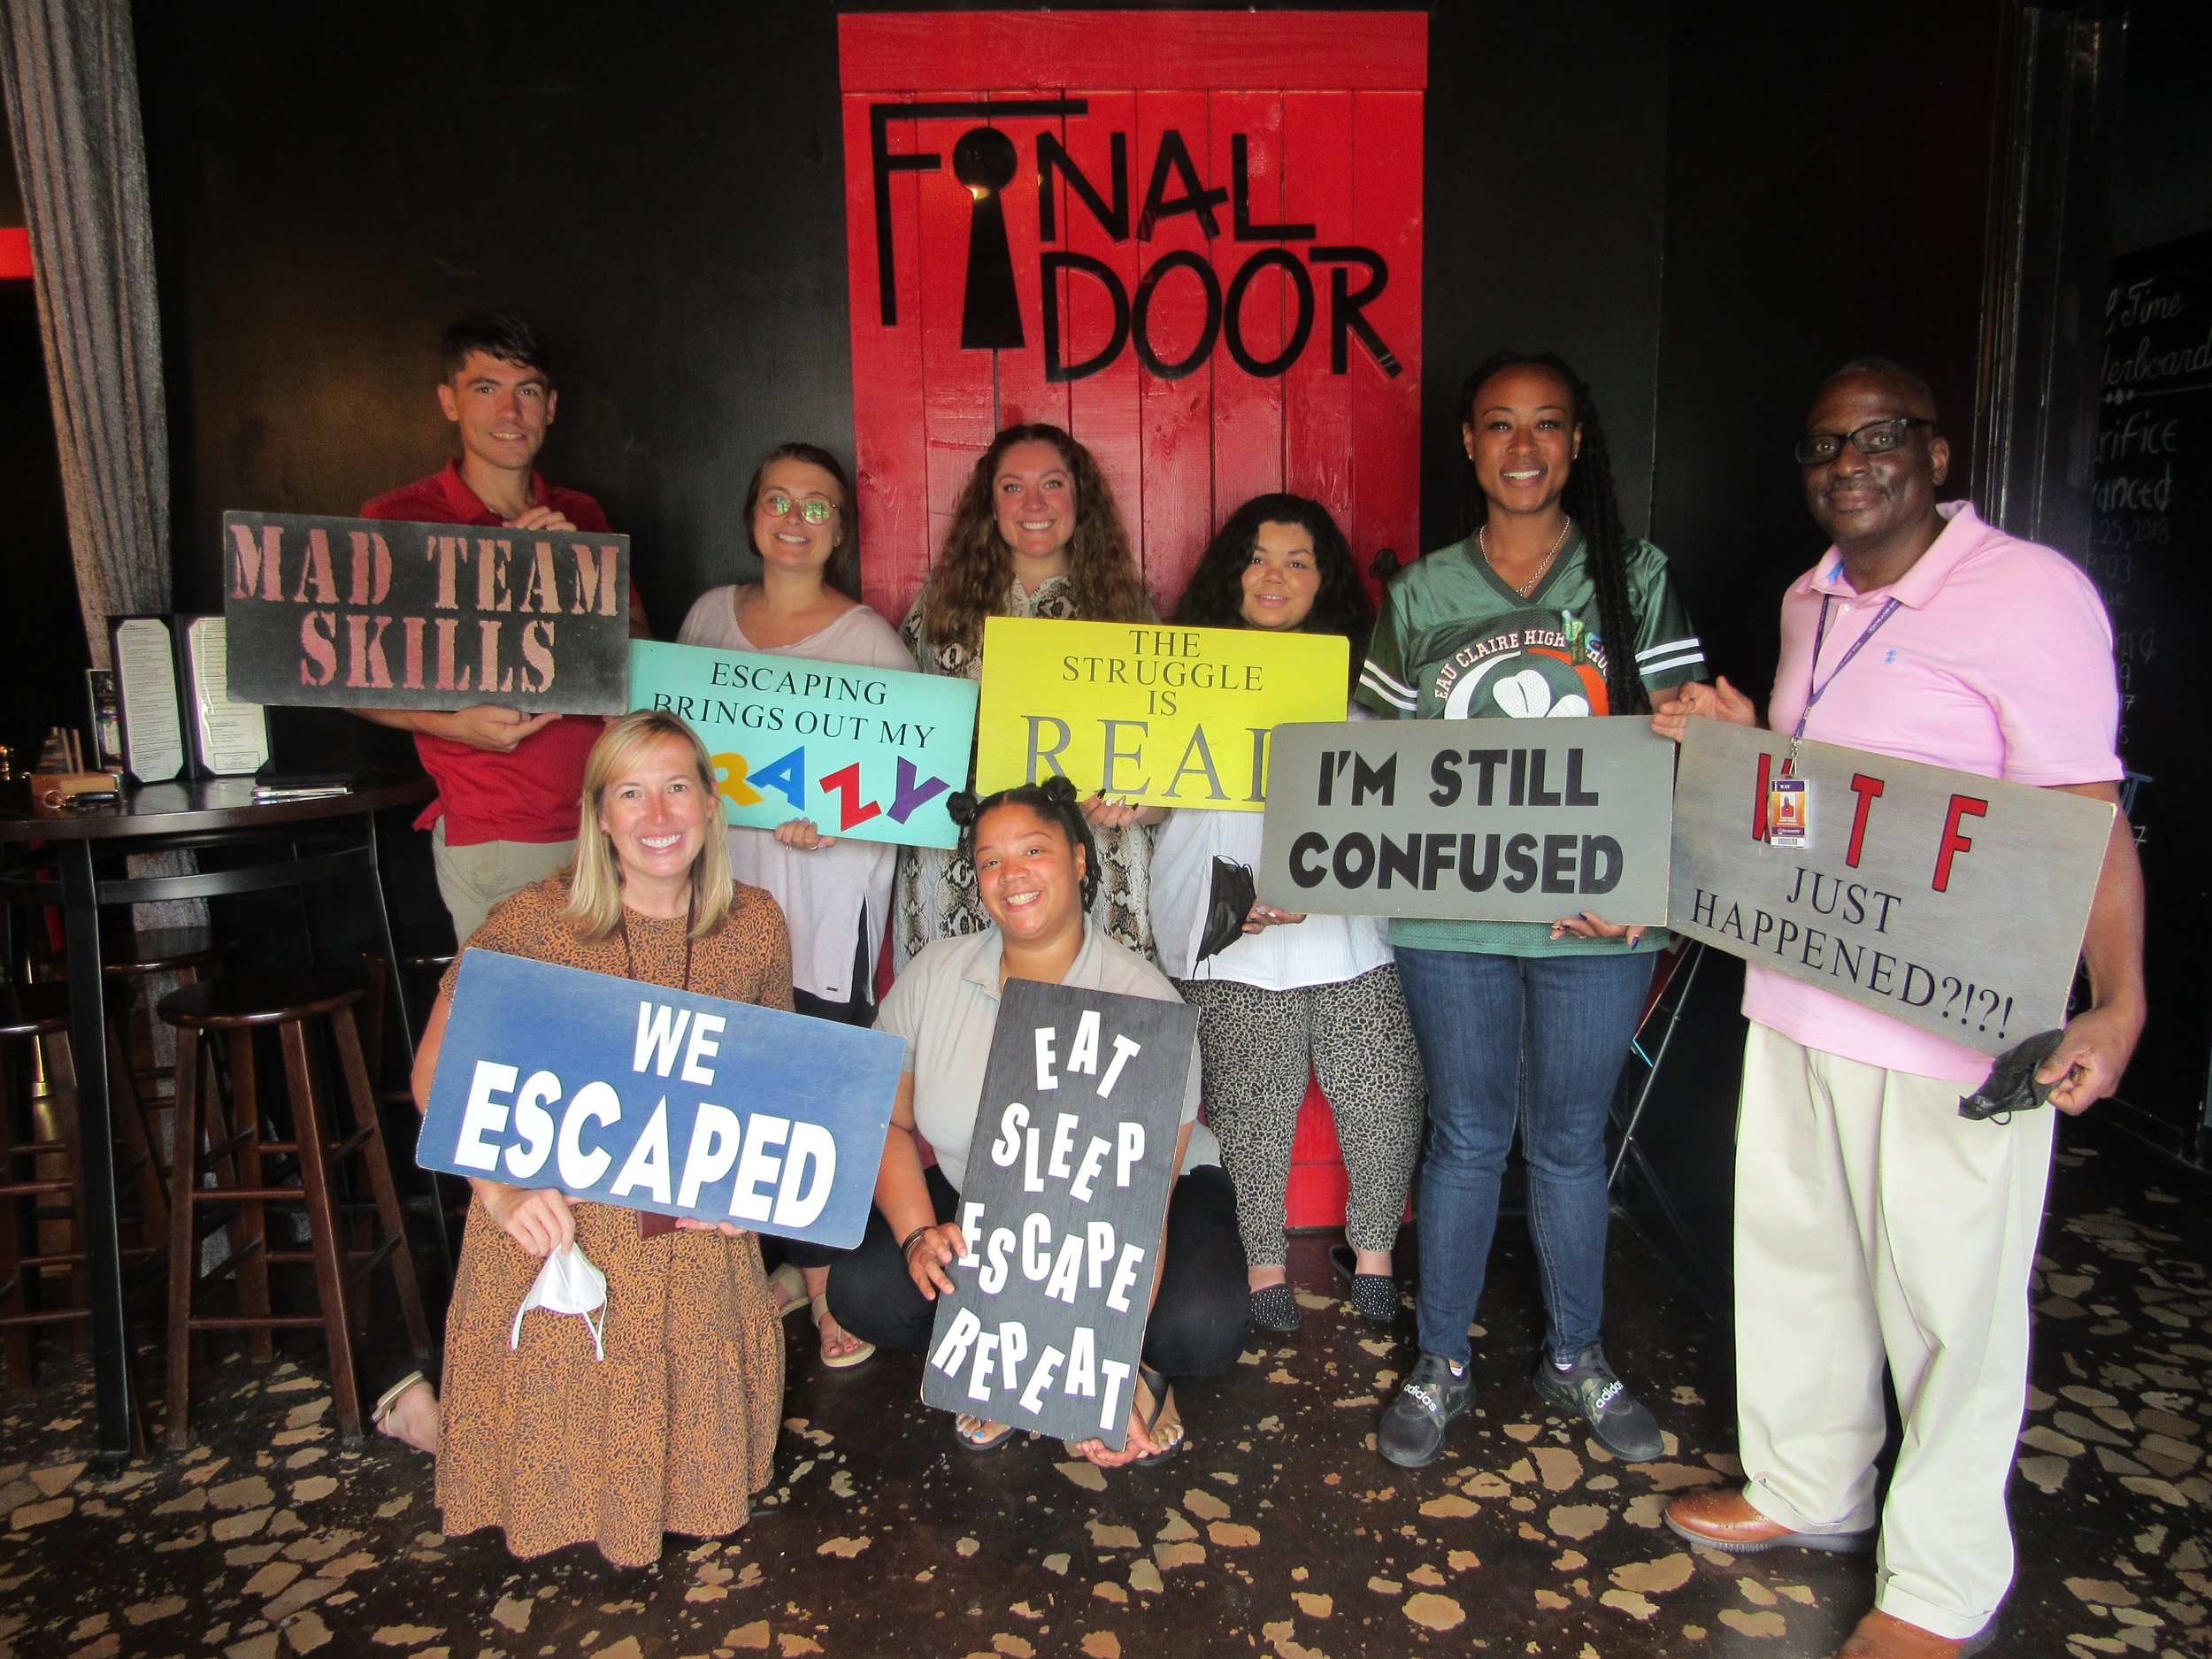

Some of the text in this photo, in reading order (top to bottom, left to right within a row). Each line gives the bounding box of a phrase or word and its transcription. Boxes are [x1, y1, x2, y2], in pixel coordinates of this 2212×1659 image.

[870, 99, 1317, 349] FINAL
[1039, 245, 1403, 383] DOOR
[2100, 326, 2212, 389] erboard
[2091, 461, 2172, 513] anced
[229, 524, 619, 617] MAD TEAM
[299, 611, 556, 694] SKILLS
[1062, 656, 1264, 692] STRUGGLE
[1128, 629, 1202, 658] THE
[1434, 629, 1565, 701] EAU CLAIRE HIGH
[652, 693, 938, 749] BRINGS OUT MY
[710, 662, 888, 706] ESCAPING
[1146, 689, 1179, 717] IS
[710, 745, 951, 833] RAZY
[1317, 749, 1600, 807] I'M STILL
[1288, 831, 1624, 895] CONFUSED
[1786, 866, 1902, 934] JUST
[1690, 887, 2015, 1040] HAPPENED?!?!
[632, 1000, 727, 1087] WE
[1034, 1010, 1142, 1099] EAT
[453, 1059, 837, 1228] ESCAPED
[991, 1102, 1146, 1203] SLEEP
[956, 1202, 1146, 1314] ESCAPE
[930, 1306, 1132, 1432] REPEAT
[1403, 1383, 1438, 1412] adidas
